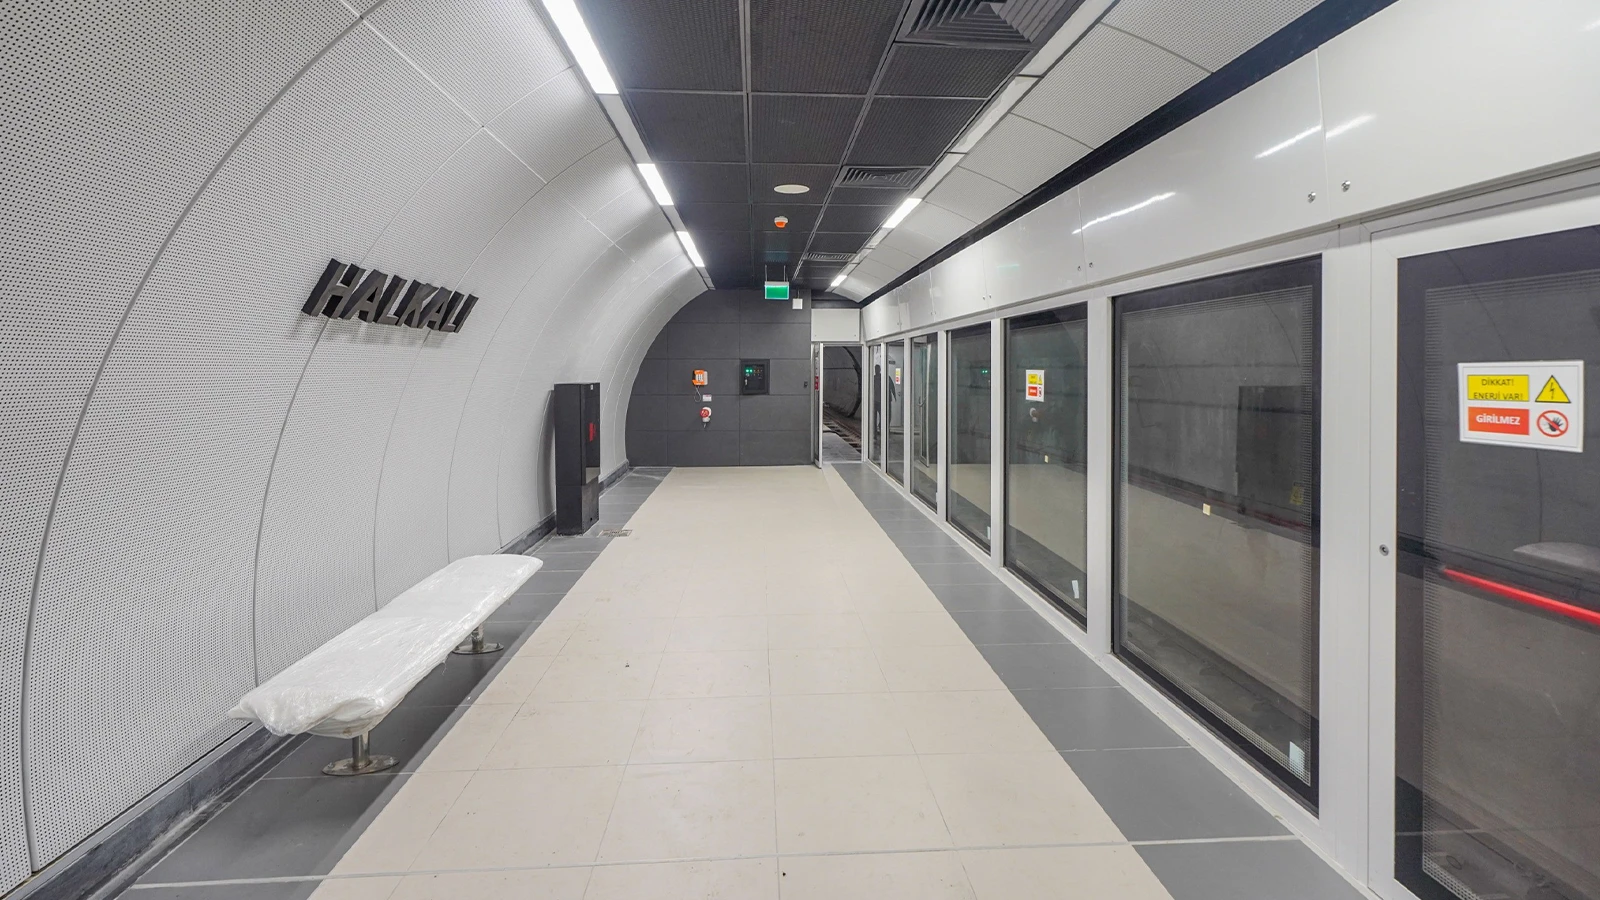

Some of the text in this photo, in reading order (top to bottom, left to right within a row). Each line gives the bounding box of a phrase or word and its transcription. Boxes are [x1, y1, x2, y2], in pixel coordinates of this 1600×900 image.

[301, 258, 479, 333] HALKALI
[1481, 377, 1514, 386] DİKKAT!
[1473, 391, 1523, 401] ENERJİ VAR!
[1476, 413, 1520, 425] GİRİLMEZ
